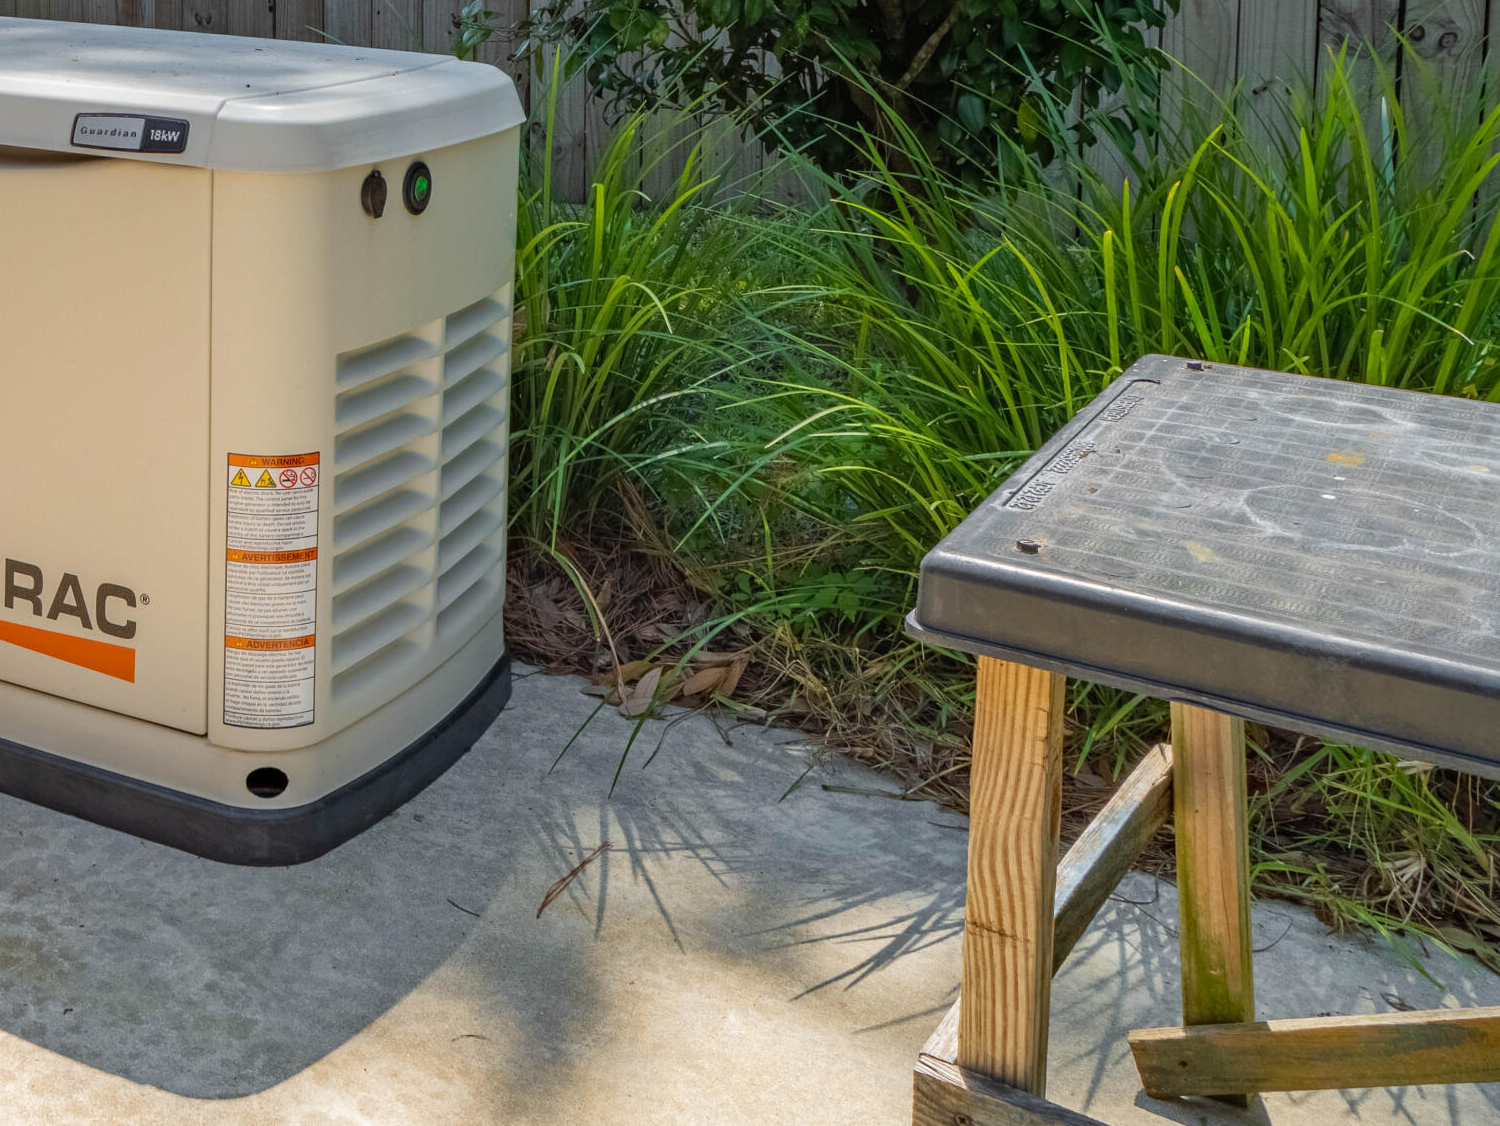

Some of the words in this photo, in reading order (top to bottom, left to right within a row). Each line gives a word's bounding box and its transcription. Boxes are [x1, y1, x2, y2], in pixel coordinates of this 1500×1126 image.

[80, 126, 137, 137] Guardian
[150, 129, 180, 142] 18kW
[262, 457, 305, 466] WARNING
[242, 551, 315, 562] AVERTISSEMENT
[246, 638, 309, 649] ADVERTENCIA
